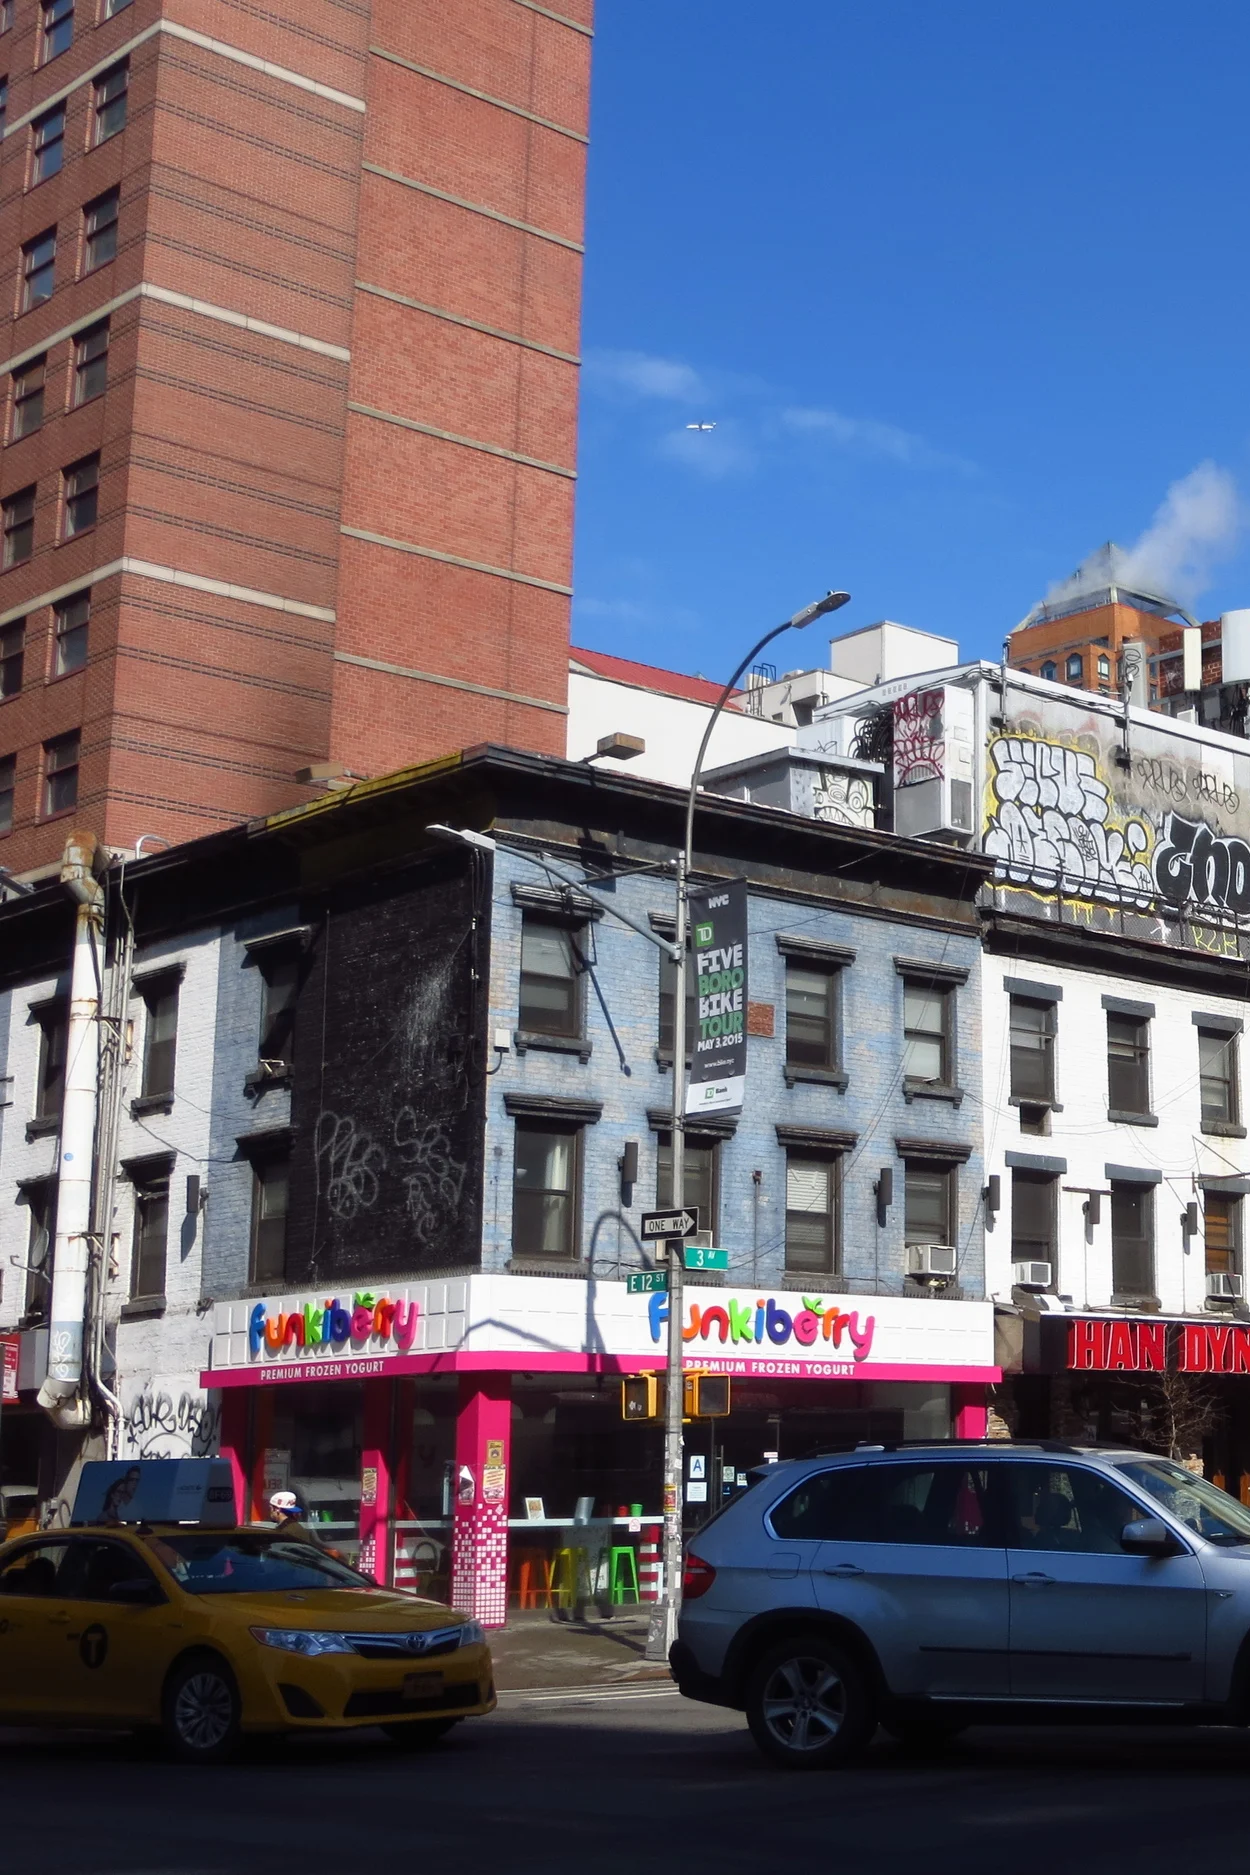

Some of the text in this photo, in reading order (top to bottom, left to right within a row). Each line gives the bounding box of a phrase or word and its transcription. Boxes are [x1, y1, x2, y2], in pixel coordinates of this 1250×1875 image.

[708, 894, 729, 909] NYC
[697, 944, 743, 976] FIVE
[698, 966, 745, 997] BORO
[699, 988, 743, 1019] BIKE
[699, 1011, 744, 1040] TOUR
[697, 1038, 715, 1053] MAY
[649, 1217, 690, 1232] ONE WAY
[696, 1250, 716, 1267] 3 AV
[631, 1273, 665, 1292] E 12 ST
[249, 1294, 420, 1351] funkiberry
[1067, 1319, 1168, 1372] HAN
[261, 1360, 384, 1381] PREMIUM FROZEN YOGURT
[751, 1361, 800, 1374] FROZEN
[805, 1363, 855, 1376] YOGURT
[692, 1458, 702, 1472] A
